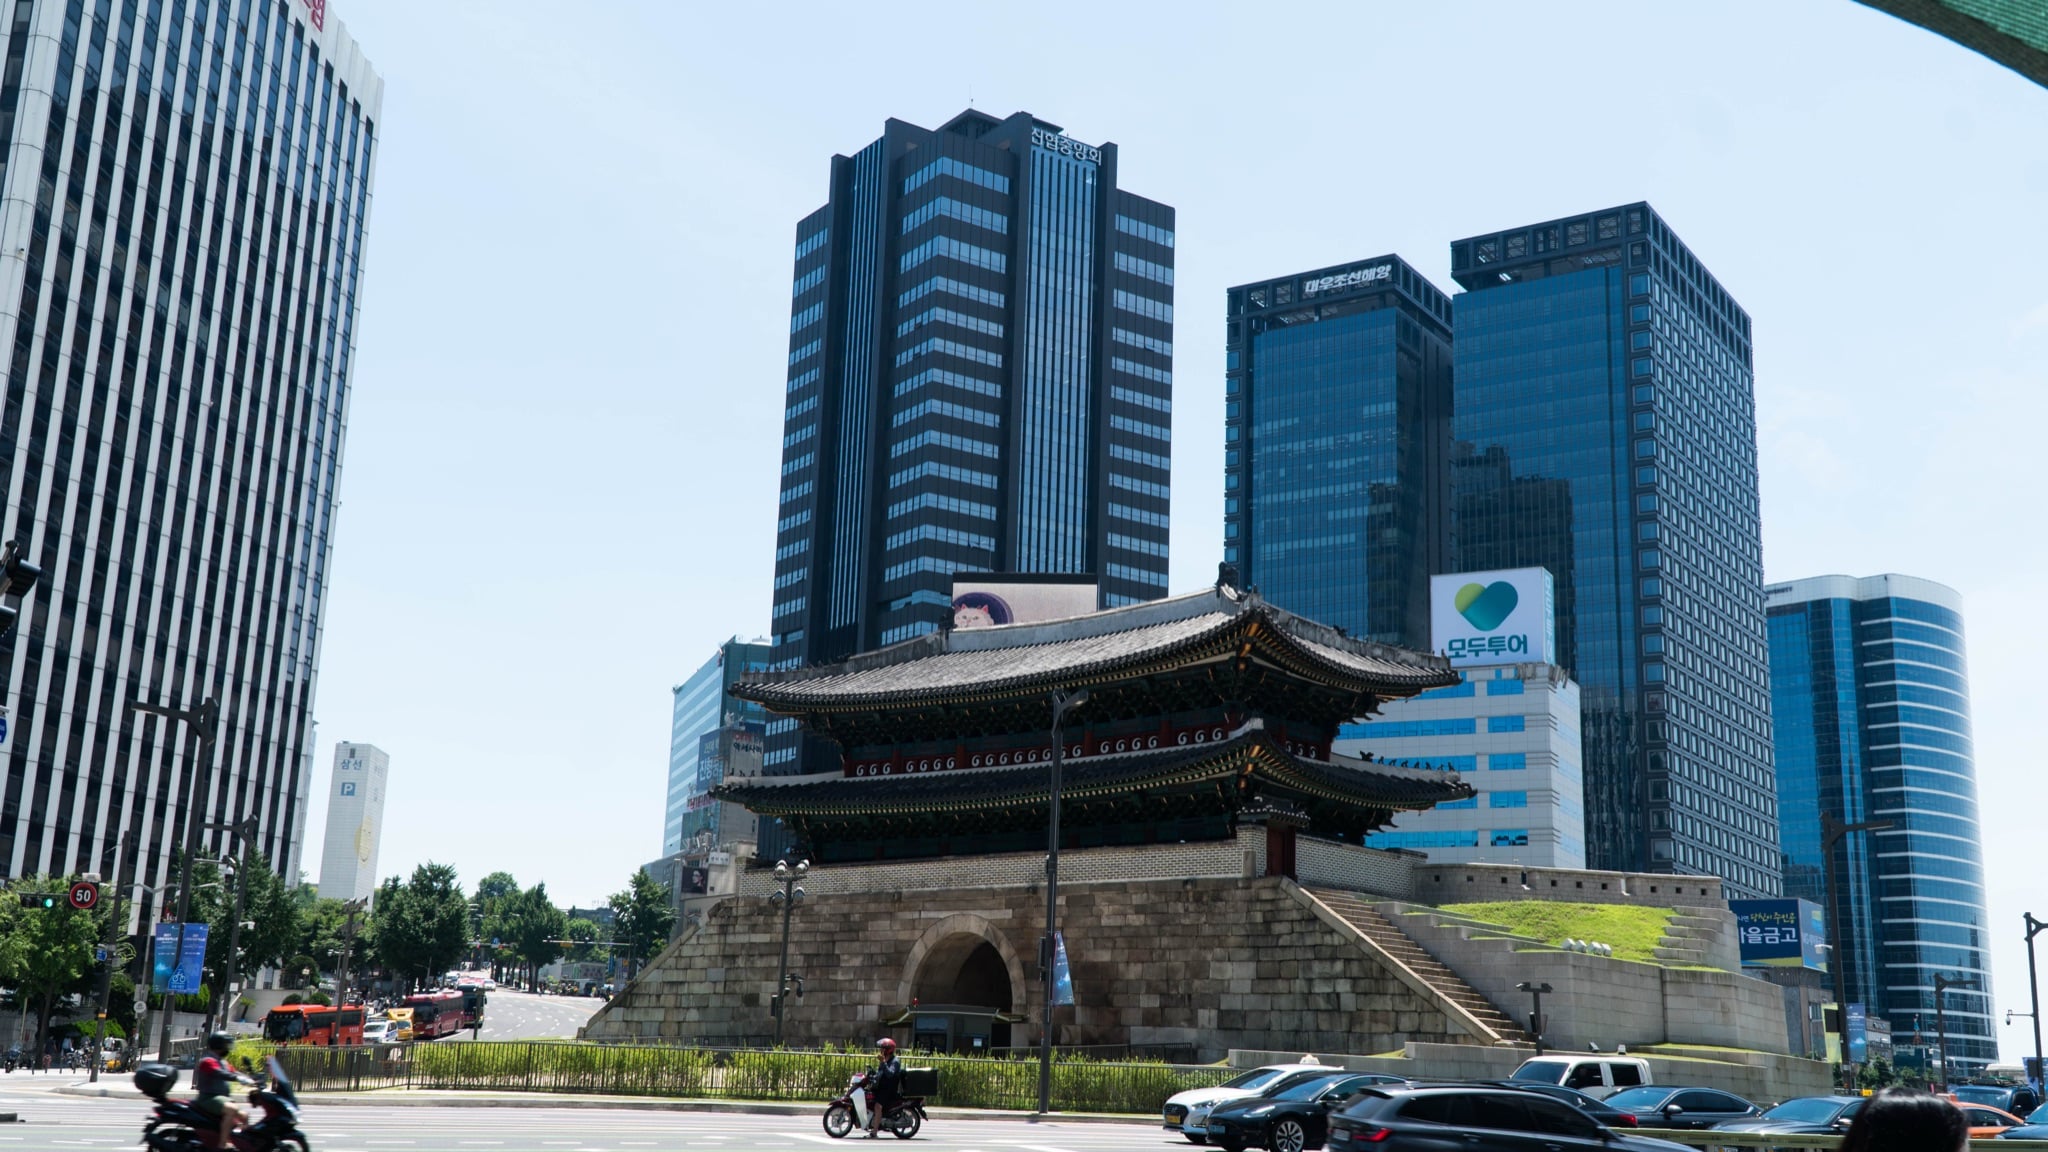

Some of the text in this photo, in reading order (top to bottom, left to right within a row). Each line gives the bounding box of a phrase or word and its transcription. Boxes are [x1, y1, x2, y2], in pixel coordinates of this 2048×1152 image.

[1031, 127, 1101, 166] 신협중앙회
[1305, 264, 1391, 292] 대우조선해양
[1448, 634, 1528, 659] 모두투어
[343, 783, 353, 796] P
[75, 889, 91, 902] 50
